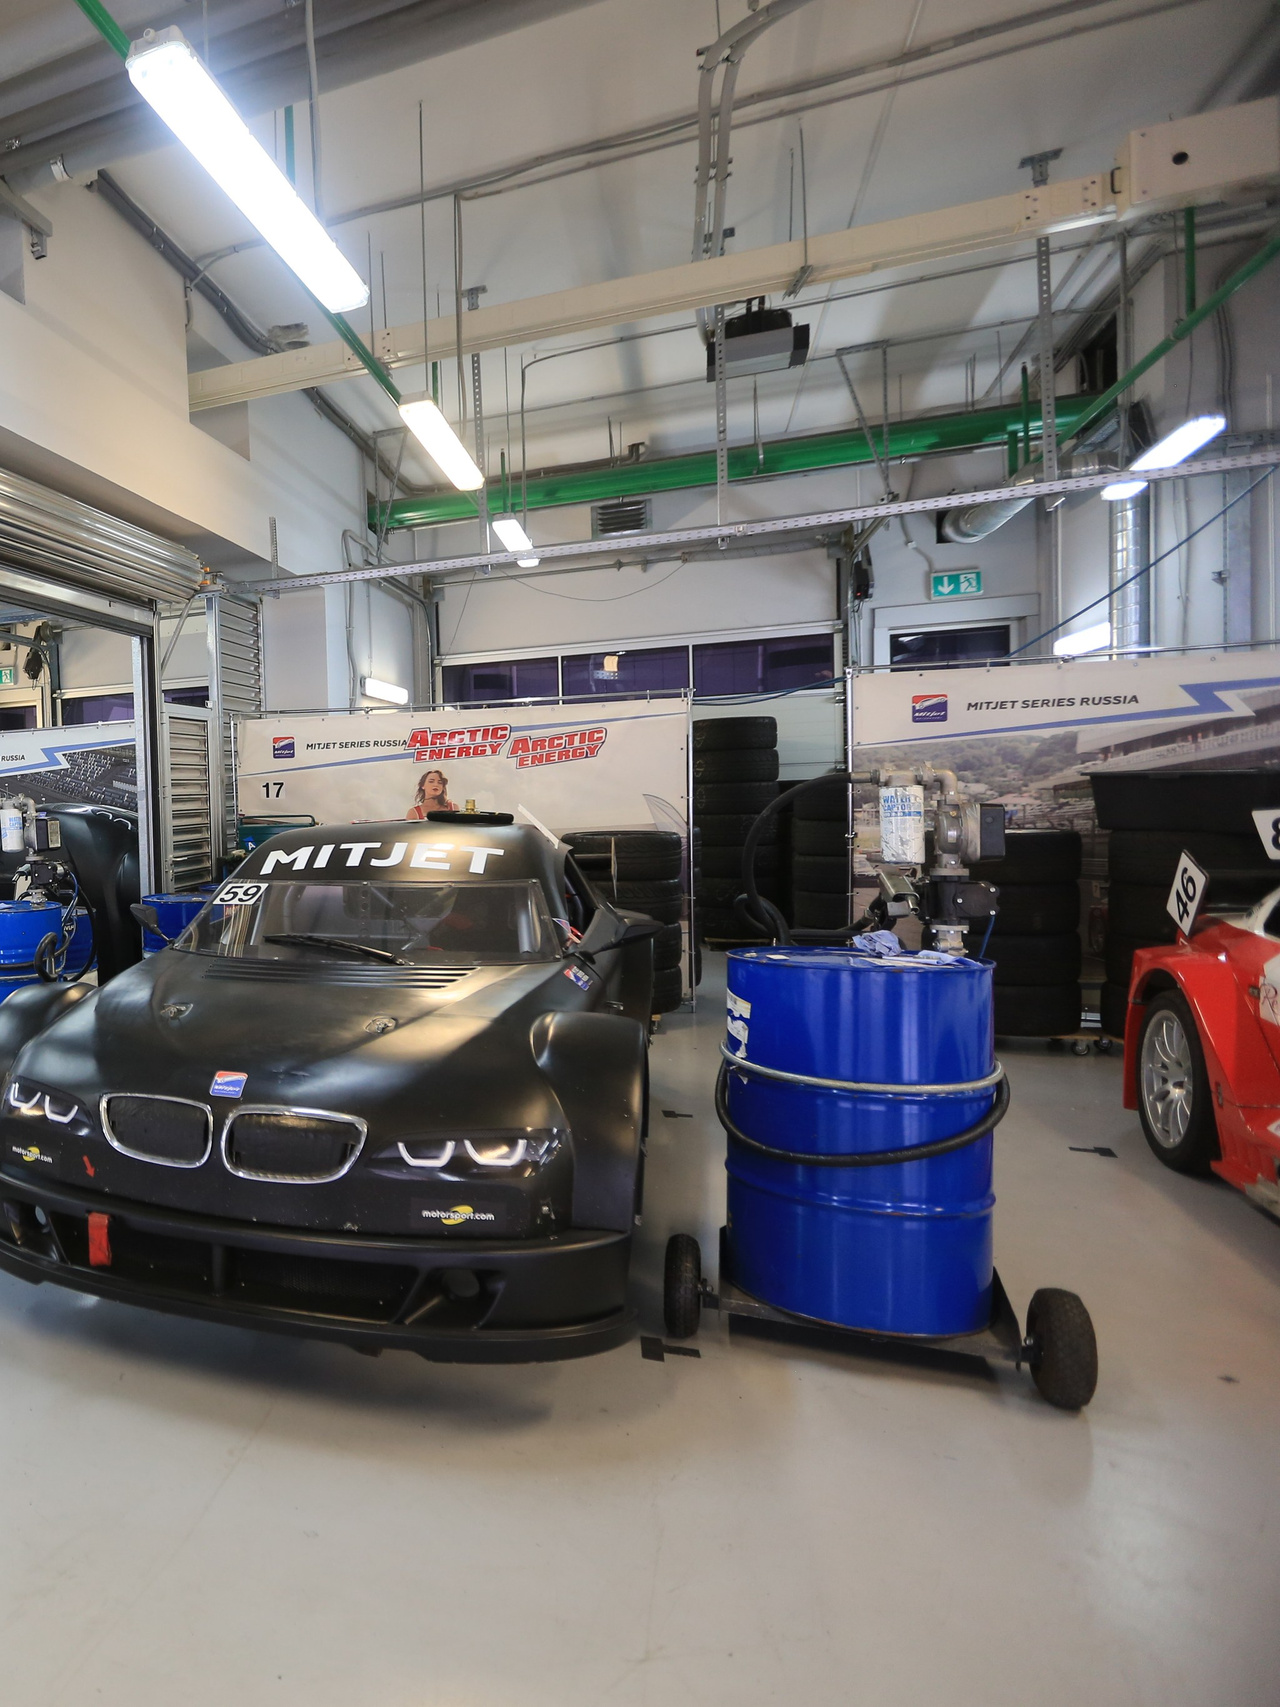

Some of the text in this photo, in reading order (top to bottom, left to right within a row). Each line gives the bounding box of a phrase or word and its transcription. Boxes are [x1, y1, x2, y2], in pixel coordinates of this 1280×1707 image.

[966, 695, 1139, 711] MITJET SERIES RUSSIA
[306, 739, 407, 750] MITJET SERIES RUSSIA
[407, 726, 509, 748] ARCTIC
[510, 729, 603, 755] ARCTIC
[416, 743, 502, 761] ENERGY
[518, 744, 600, 767] ENERGY
[262, 782, 285, 799] 17
[259, 842, 505, 875] MITJET
[219, 885, 262, 903] 59
[1175, 867, 1197, 924] 46
[12, 1145, 53, 1164] motorsport.com
[421, 1209, 495, 1221] motorsport.com
